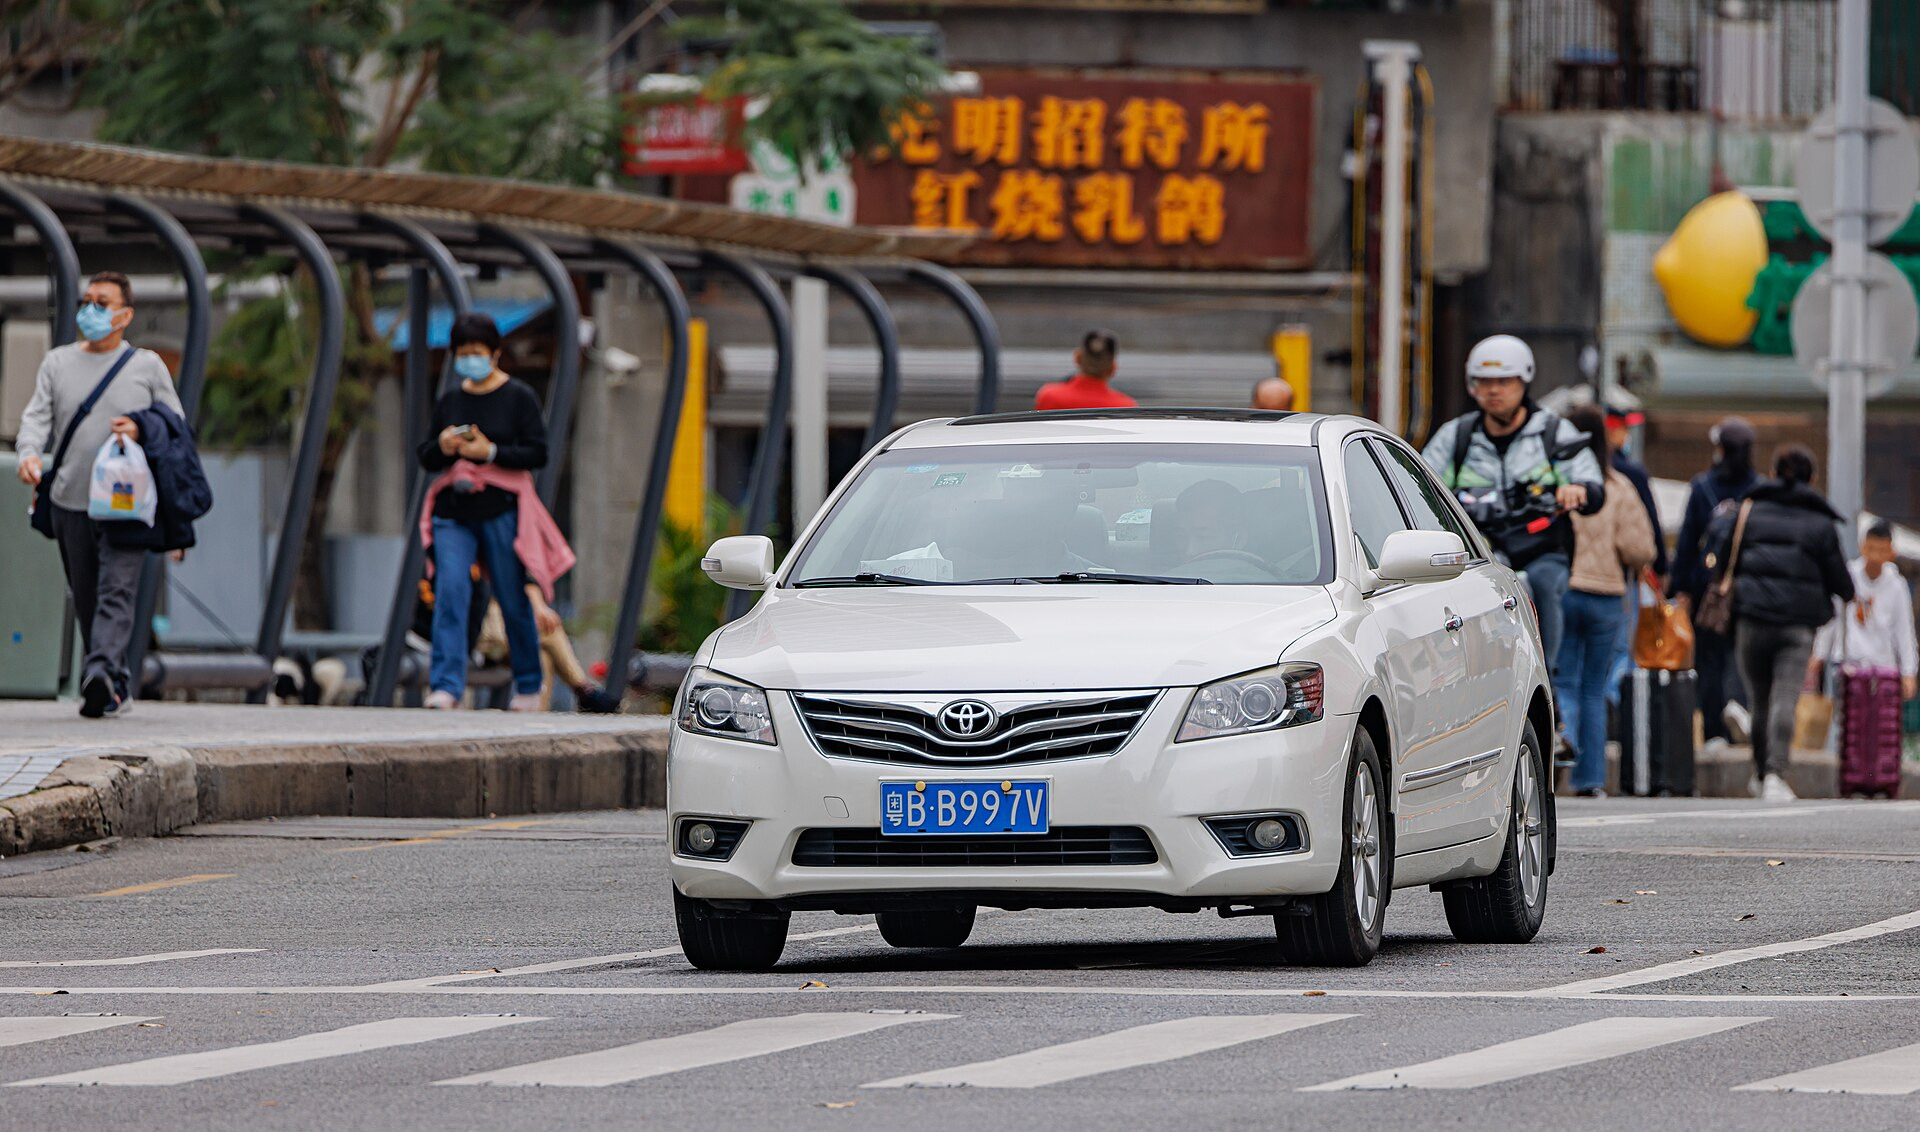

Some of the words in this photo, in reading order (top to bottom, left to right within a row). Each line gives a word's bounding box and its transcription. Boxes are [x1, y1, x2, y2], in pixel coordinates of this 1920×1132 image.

[912, 170, 1227, 243] 红烧乳鸽
[886, 789, 1043, 827] 粤B·B997V
